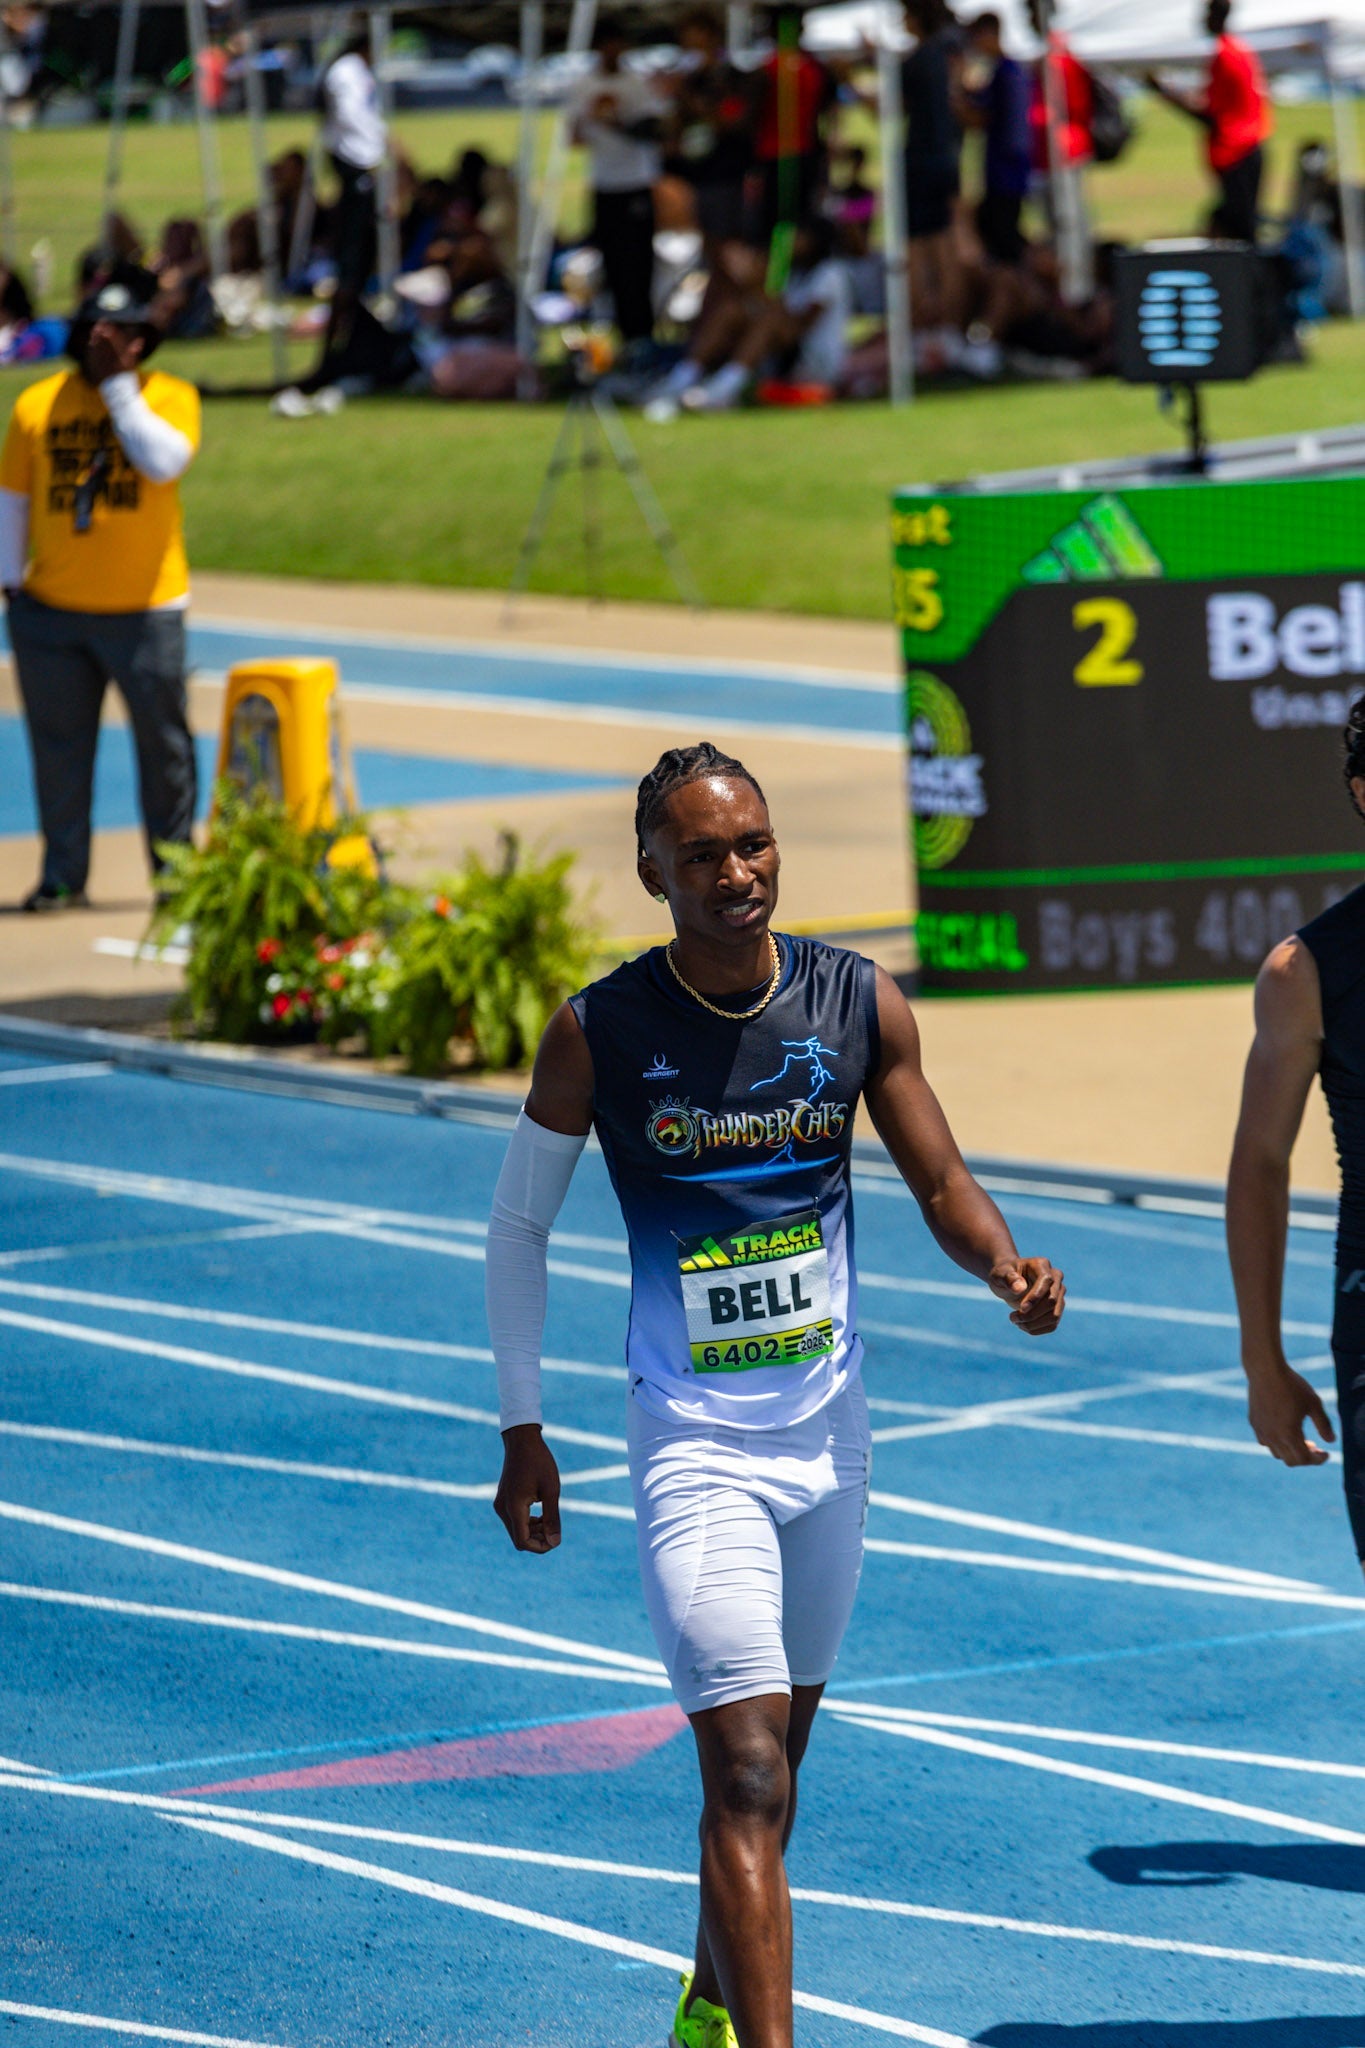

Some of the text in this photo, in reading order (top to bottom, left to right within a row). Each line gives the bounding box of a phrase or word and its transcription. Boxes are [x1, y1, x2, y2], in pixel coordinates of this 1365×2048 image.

[1071, 581, 1365, 687] 2 Bel
[1039, 901, 1175, 982] Boys
[1195, 888, 1304, 966] 400
[643, 1069, 680, 1079] DIVERGENT
[730, 1221, 820, 1254] TRACK
[732, 1237, 821, 1265] NATIONALS
[707, 1273, 812, 1325] BELL
[702, 1338, 781, 1367] 6402
[800, 1334, 824, 1351] 2026
